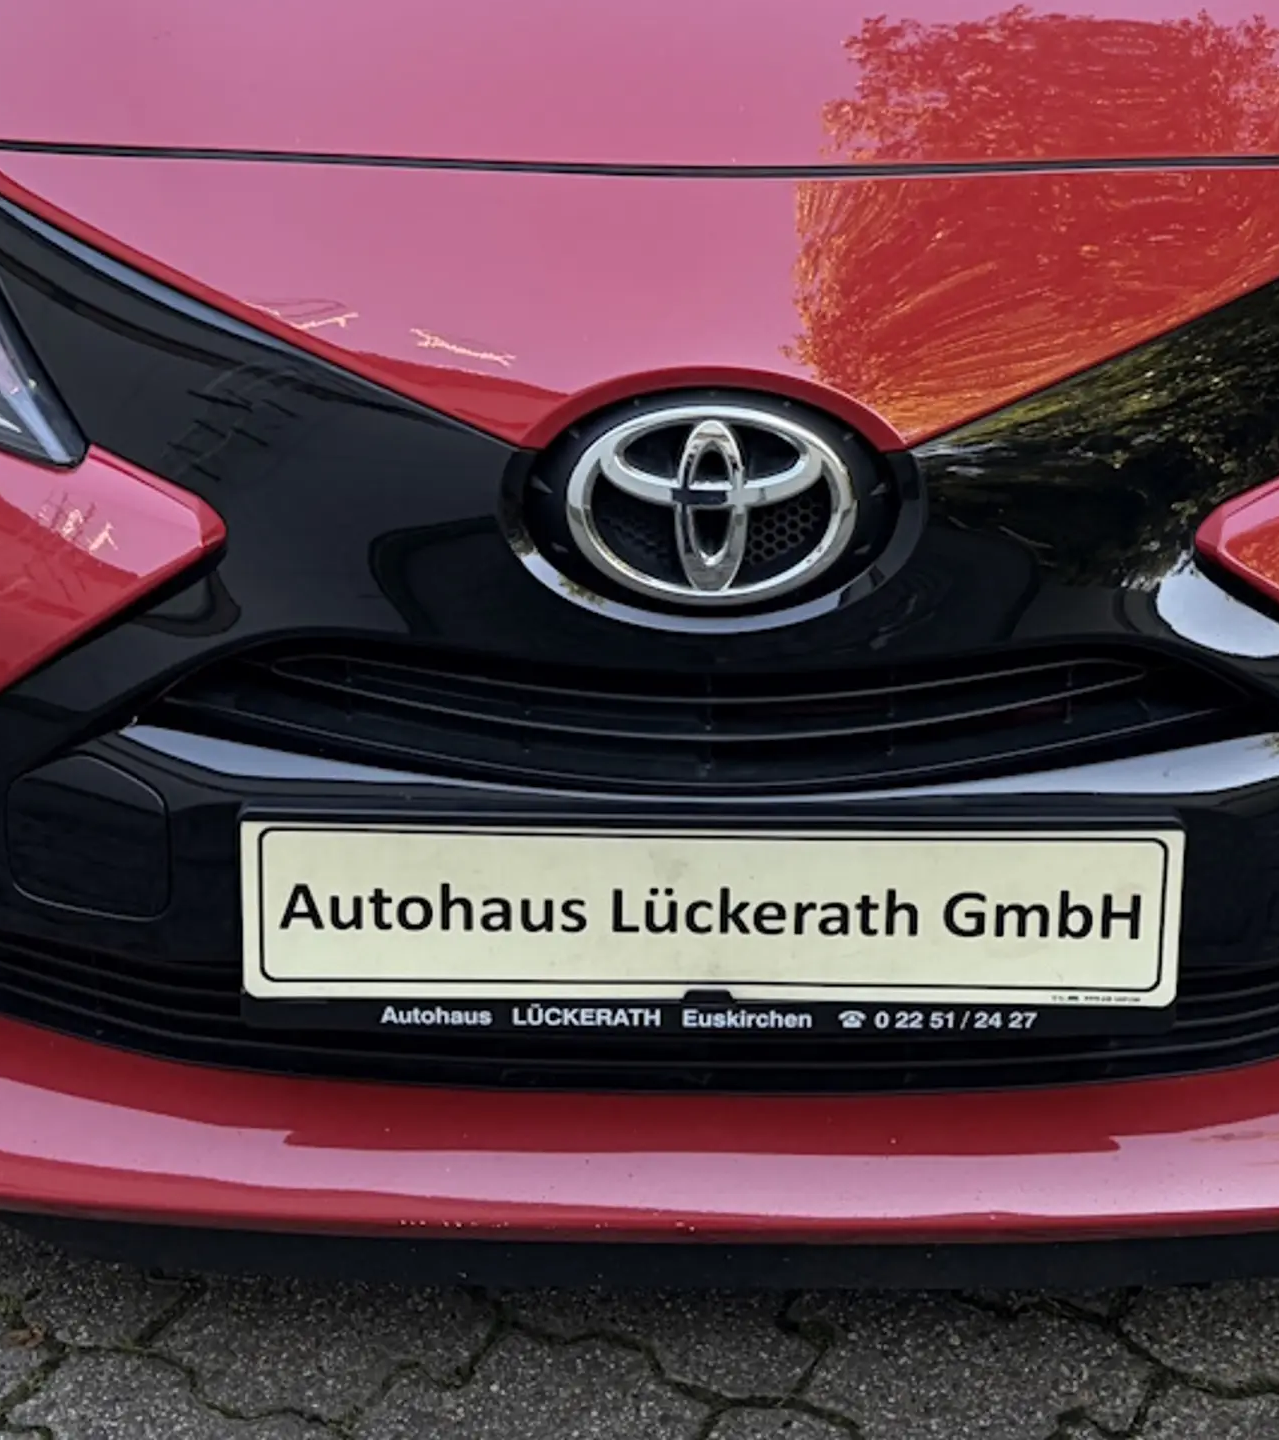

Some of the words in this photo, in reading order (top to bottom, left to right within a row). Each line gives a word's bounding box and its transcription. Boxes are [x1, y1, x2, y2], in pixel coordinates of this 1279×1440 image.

[279, 882, 588, 933] Autohaus
[612, 886, 920, 938] Lückerath
[943, 889, 1143, 940] GmbH
[380, 1006, 493, 1027] Autohaus
[512, 1003, 662, 1027] LÜCKERATH
[682, 1008, 813, 1029] Euskirchen
